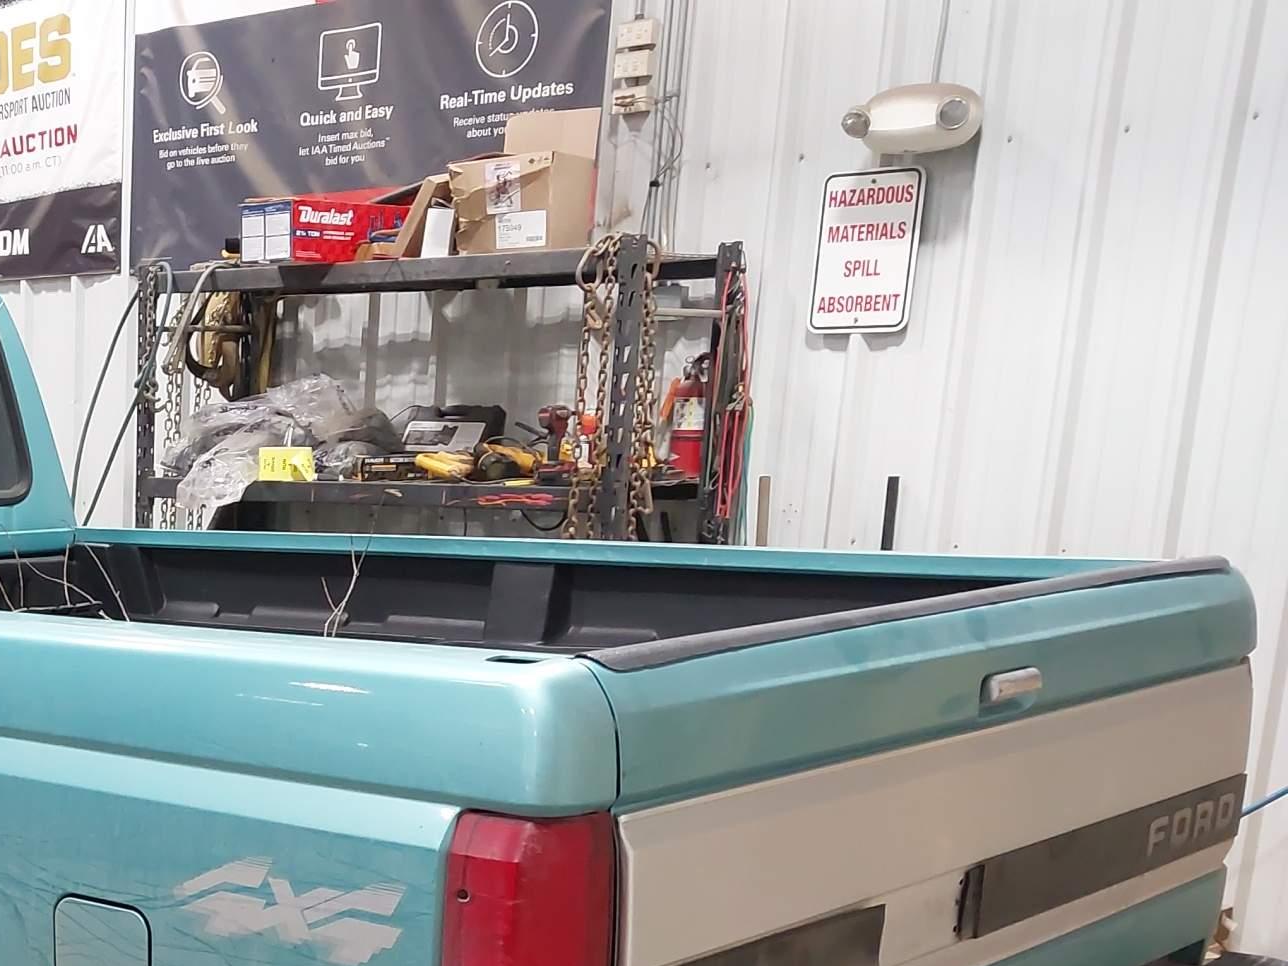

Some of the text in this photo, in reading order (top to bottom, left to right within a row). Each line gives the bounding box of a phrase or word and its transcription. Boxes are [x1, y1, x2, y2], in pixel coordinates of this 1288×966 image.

[32, 88, 71, 113] AUCTION
[440, 82, 574, 110] Real-Time Updates
[300, 104, 394, 126] Quick and Easy
[453, 114, 486, 128] Receive
[487, 111, 514, 123] statu
[0, 124, 78, 158] AUCTION
[152, 118, 258, 143] Exclusive First Look
[318, 127, 374, 142] Insert max bid,
[466, 127, 491, 138] about
[158, 149, 168, 159] Bid
[169, 149, 178, 158] on
[178, 146, 207, 156] vehicles
[208, 143, 229, 153] before
[299, 146, 309, 156] let
[311, 145, 328, 155] IAA
[328, 142, 352, 153] Timed
[166, 154, 236, 170] go to the live auction
[325, 154, 365, 166] bid for you
[829, 184, 914, 208] HAZARDOUS
[298, 205, 354, 226] Duralast
[827, 221, 907, 243] MATERIALS
[843, 259, 881, 278] SPILL
[817, 293, 901, 314] ABSORBENT
[1146, 792, 1236, 857] FORD
